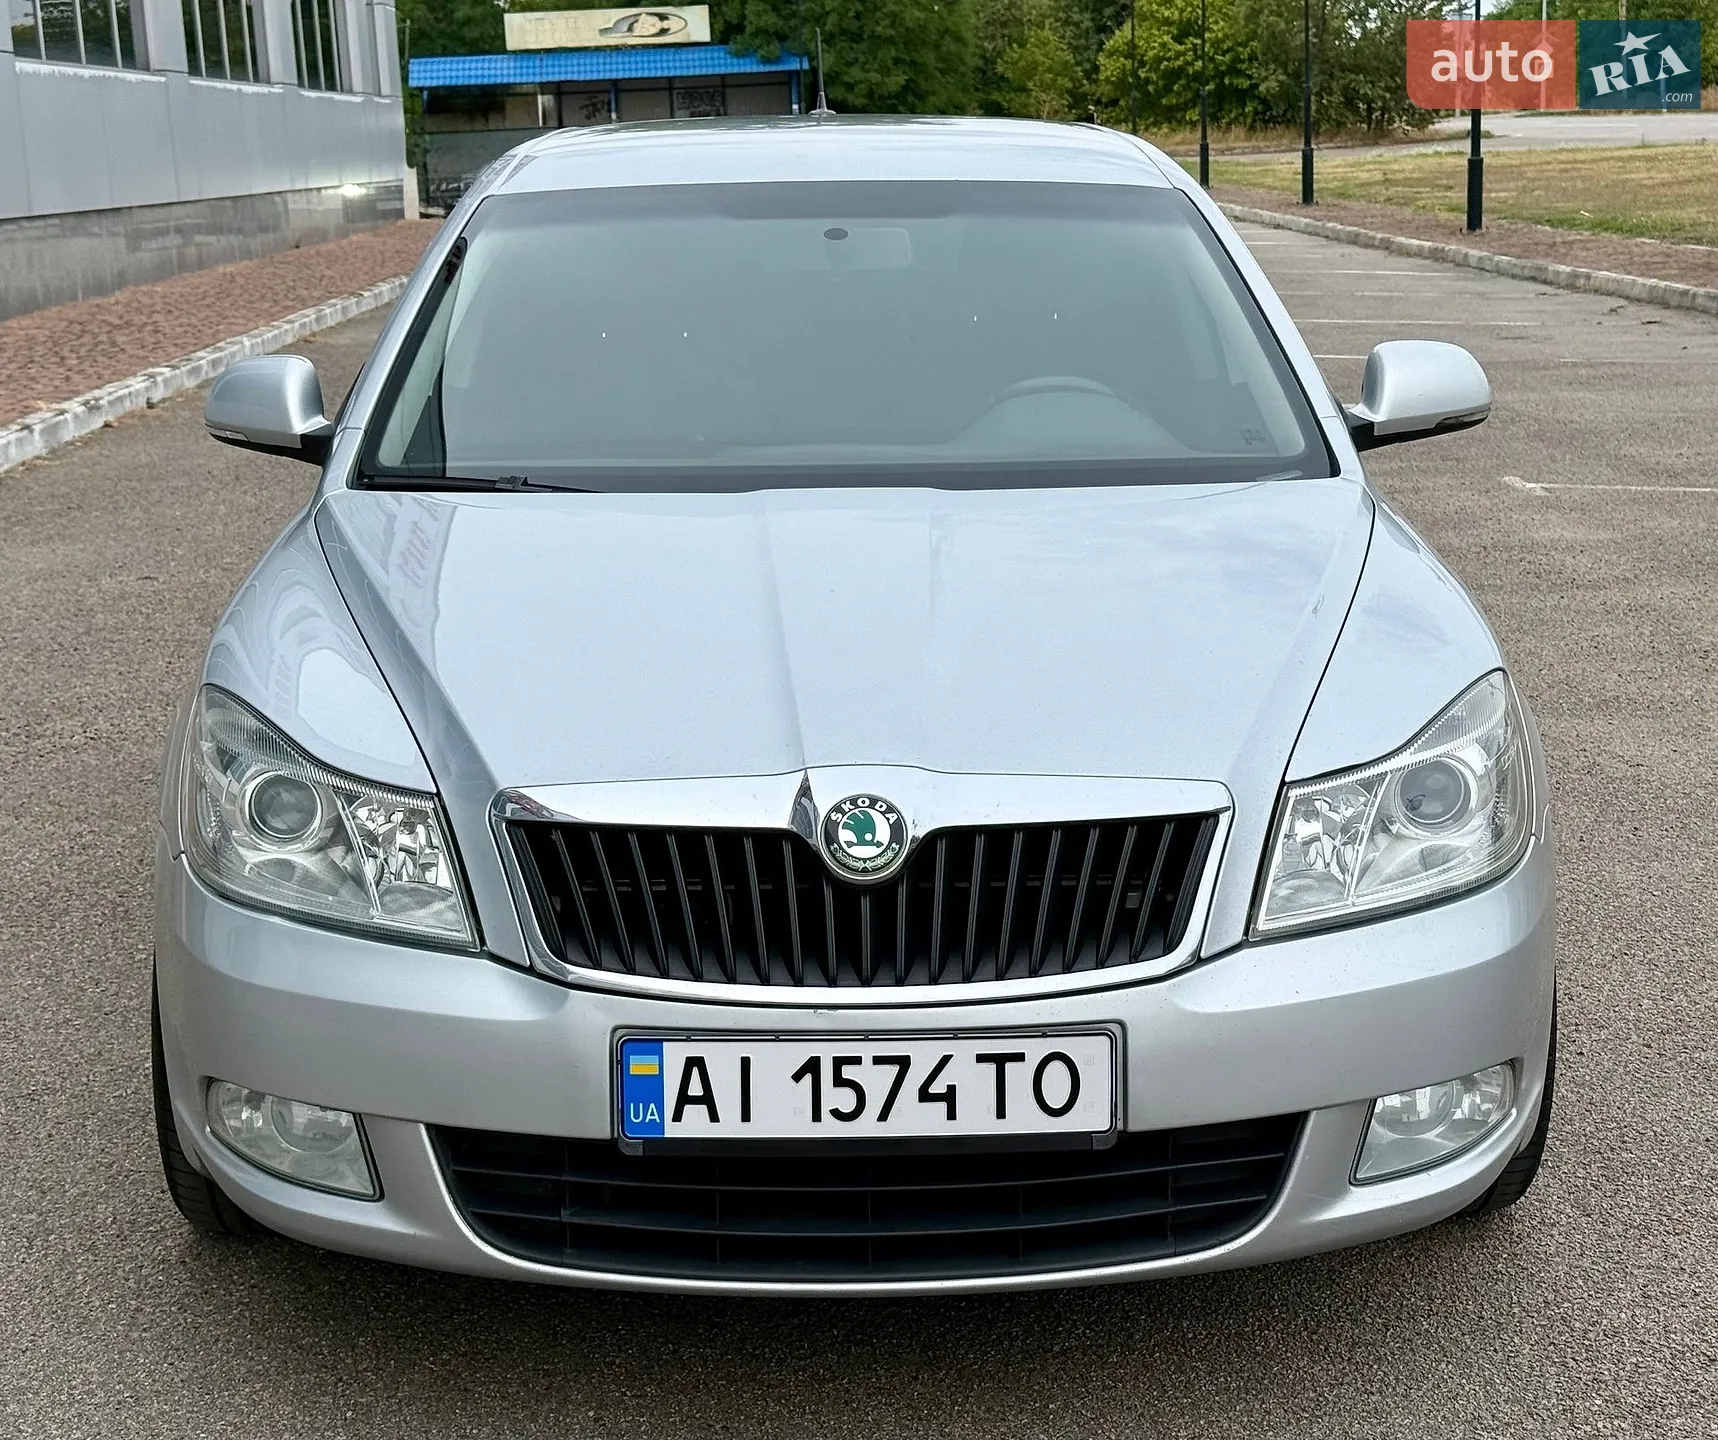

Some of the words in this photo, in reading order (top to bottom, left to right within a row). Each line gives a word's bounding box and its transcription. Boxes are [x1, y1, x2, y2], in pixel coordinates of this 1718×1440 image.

[671, 1055, 751, 1123] AI
[790, 1053, 958, 1123] 1574
[975, 1050, 1082, 1120] TO
[630, 1102, 661, 1123] UA
